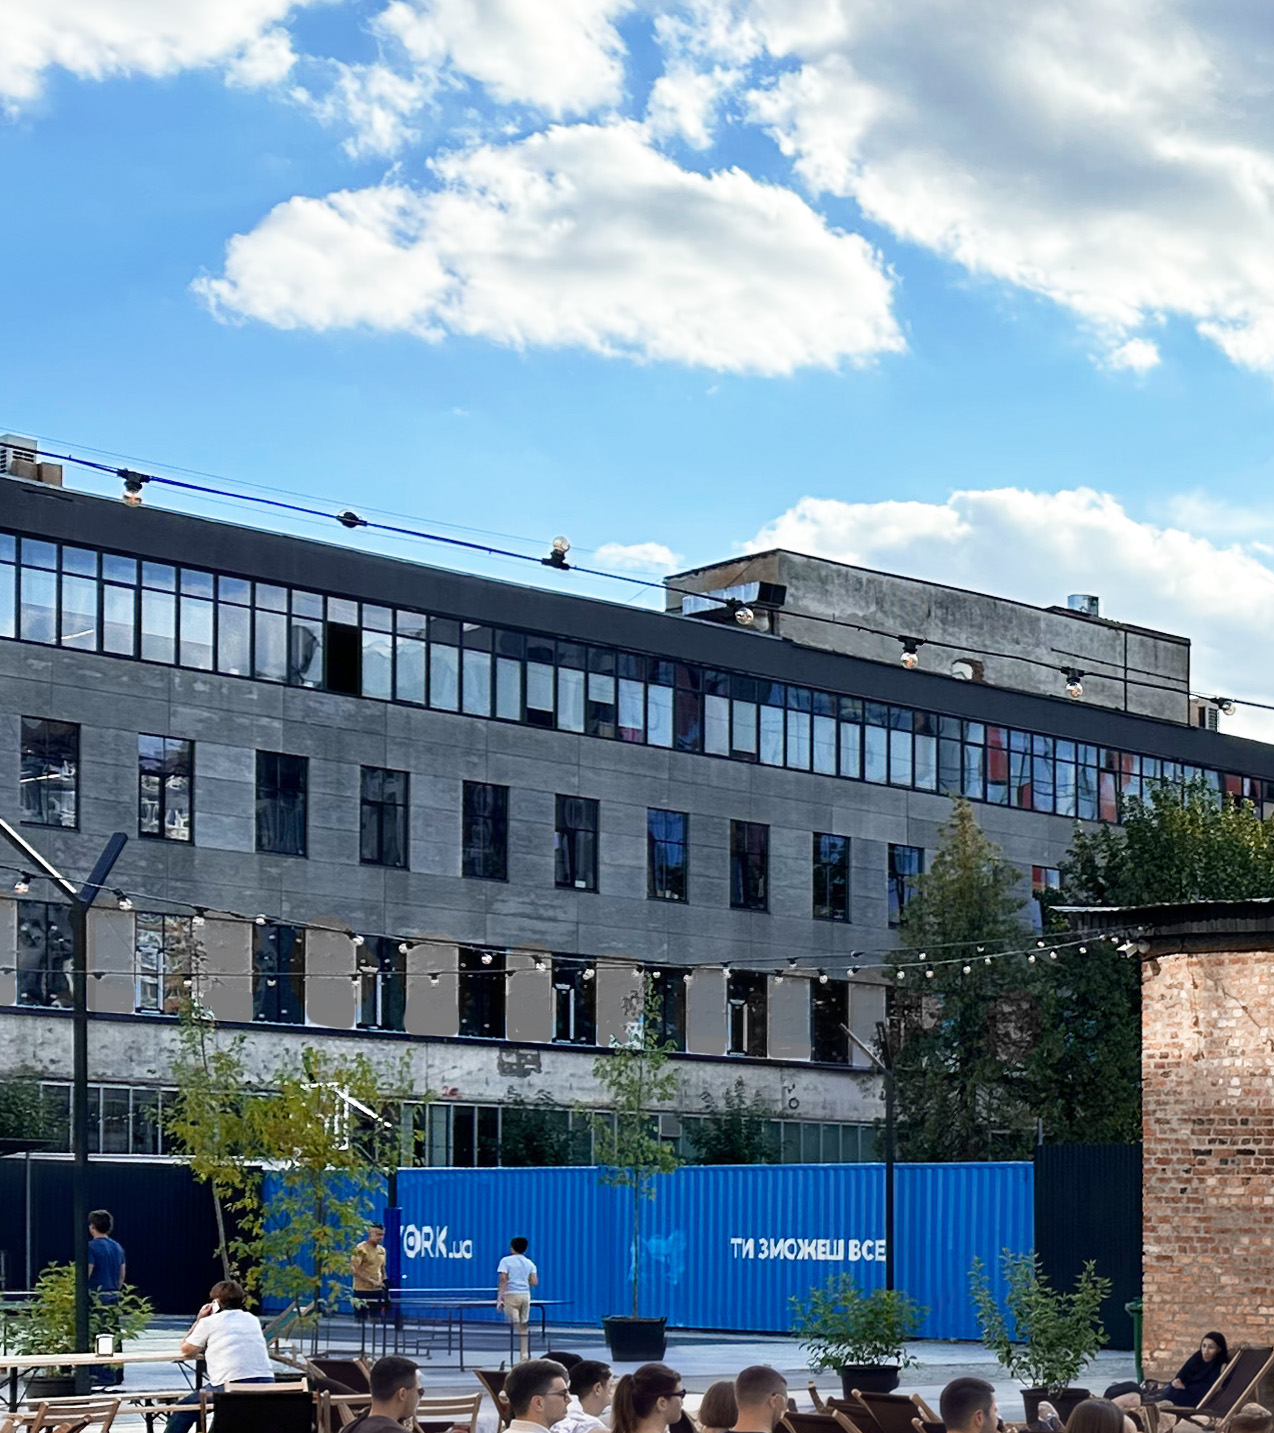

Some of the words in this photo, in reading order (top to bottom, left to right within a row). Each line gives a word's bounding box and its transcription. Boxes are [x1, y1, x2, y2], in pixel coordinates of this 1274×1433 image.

[400, 1223, 473, 1259] ORK.ua
[730, 1237, 755, 1259] ТИ
[758, 1237, 845, 1261] ЗМОЖЕШ
[848, 1239, 887, 1262] ВСЕ
